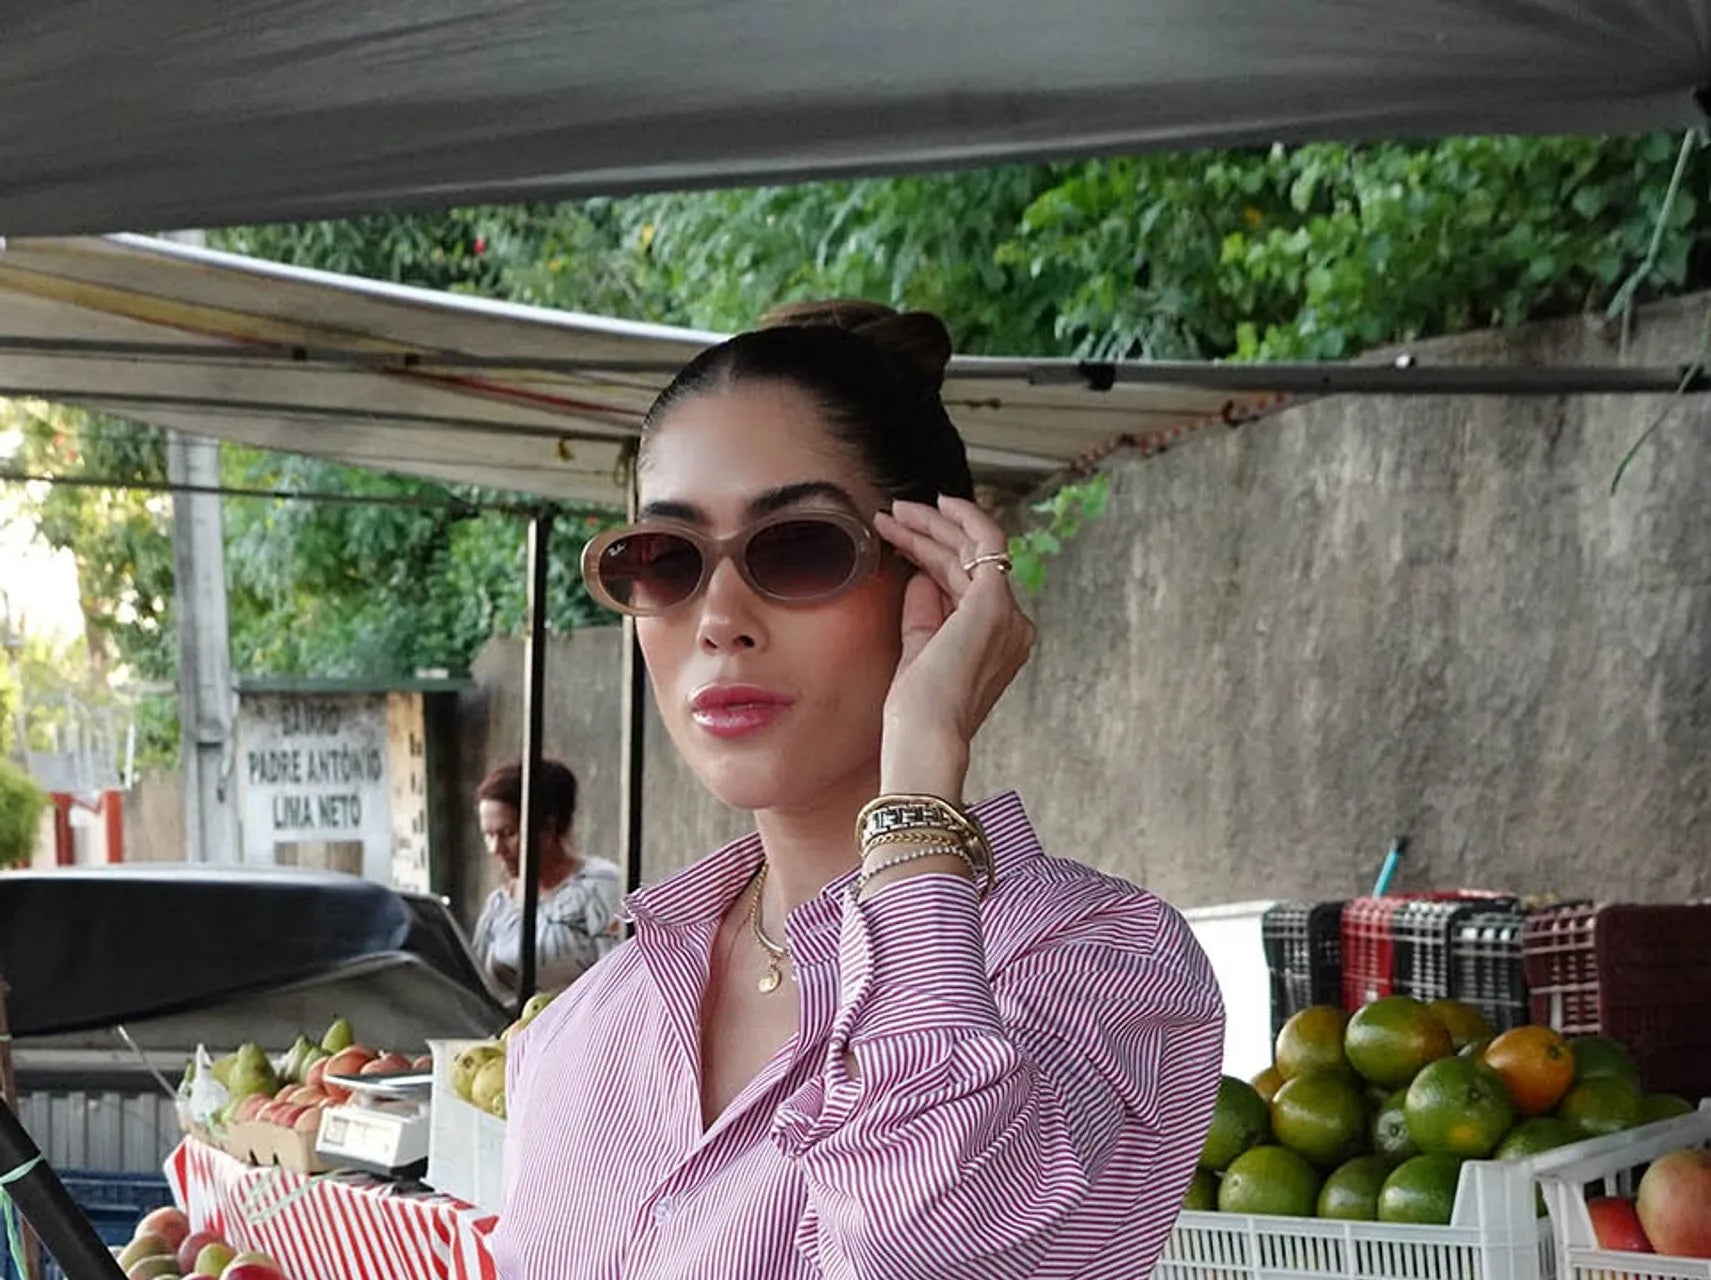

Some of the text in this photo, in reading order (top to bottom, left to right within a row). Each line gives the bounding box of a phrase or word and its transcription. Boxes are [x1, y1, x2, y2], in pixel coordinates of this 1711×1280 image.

[248, 750, 302, 785] PADRE
[273, 793, 362, 829] LIMA NETO
